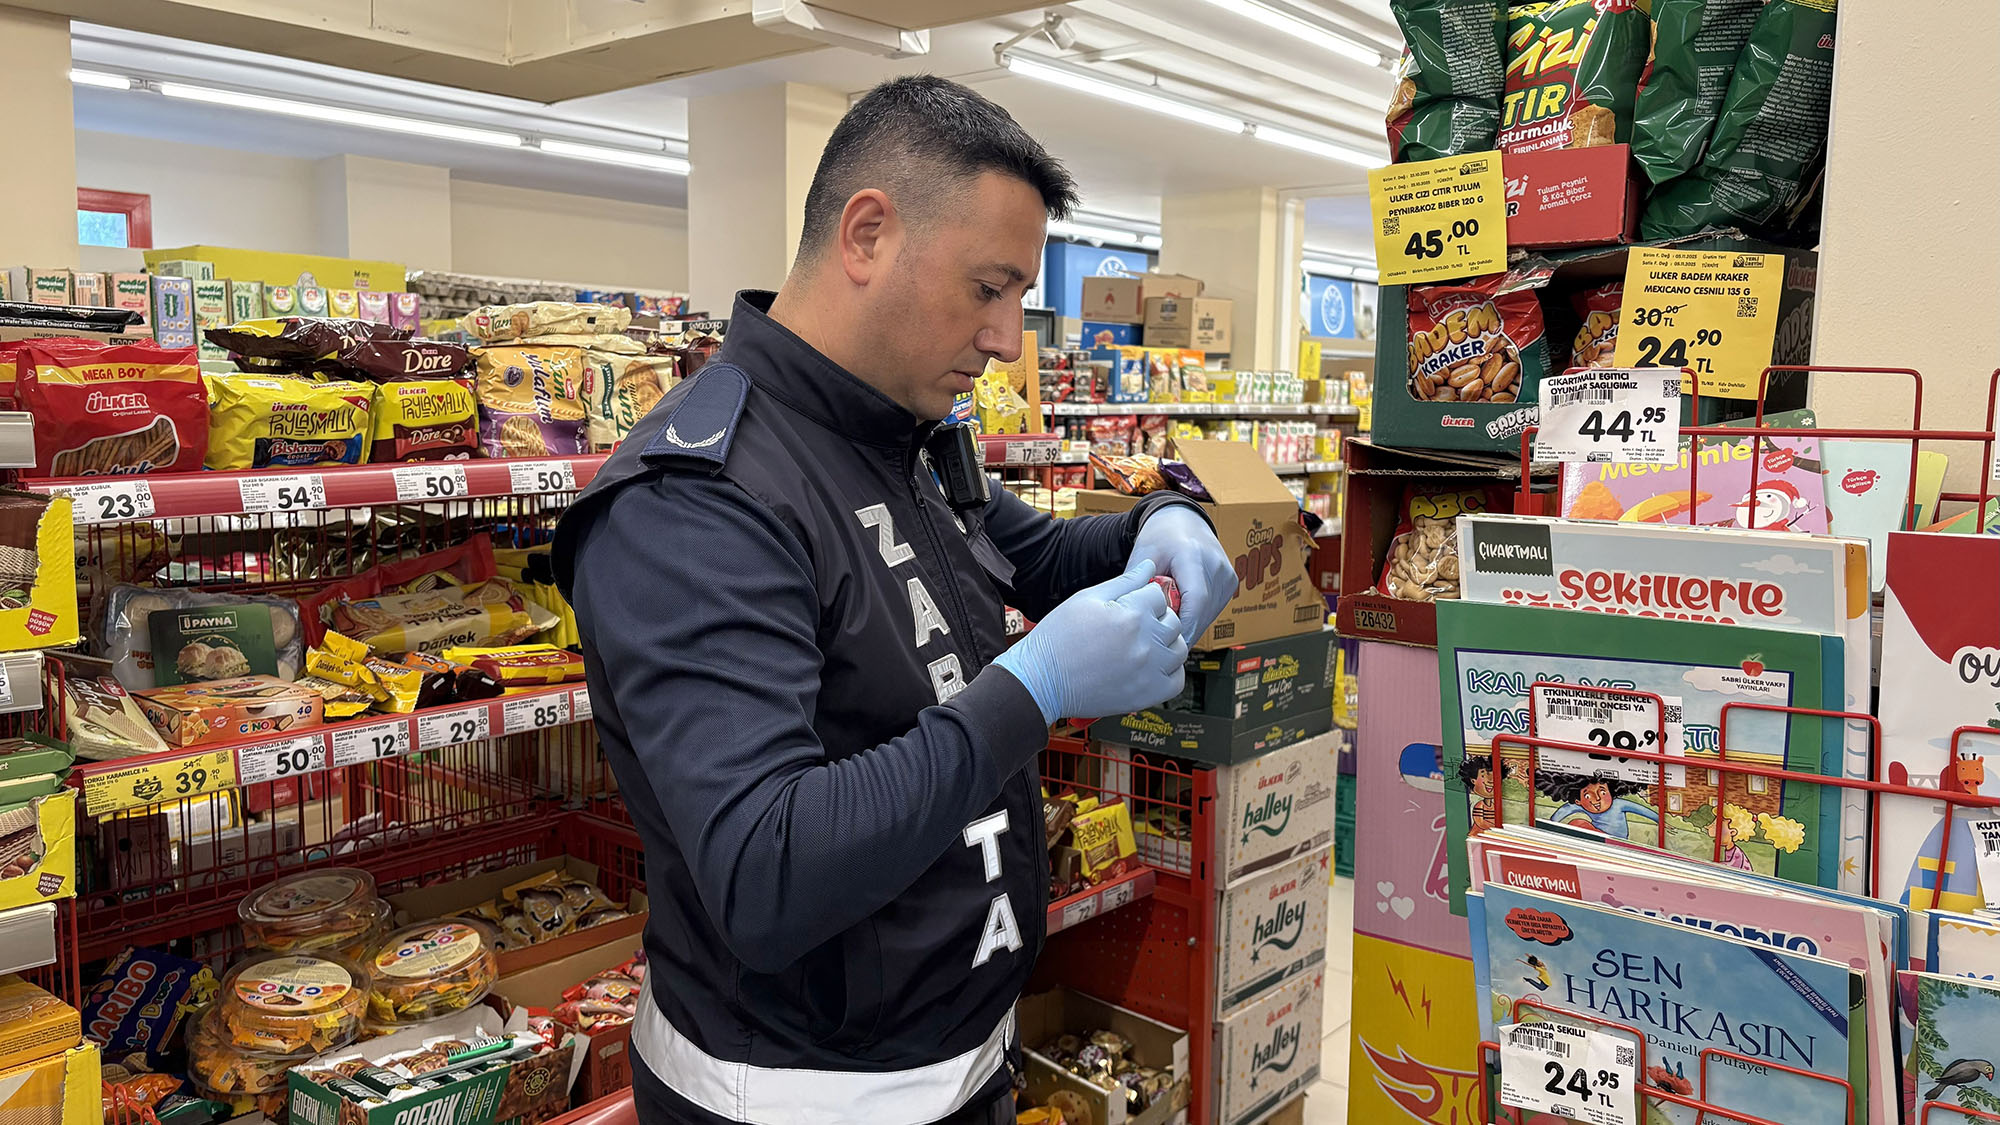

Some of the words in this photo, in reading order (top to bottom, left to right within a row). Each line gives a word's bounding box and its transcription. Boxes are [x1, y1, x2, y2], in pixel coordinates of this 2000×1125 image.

[1389, 192, 1414, 203] ULKER
[1415, 190, 1430, 199] CIZI
[1432, 186, 1452, 196] CITIR
[1452, 181, 1481, 193] TULUM
[1536, 184, 1560, 196] Tulum
[1561, 176, 1588, 190] Peyniri
[1542, 194, 1549, 202] &
[1550, 190, 1564, 201] Köz
[1566, 186, 1586, 197] Biber
[1388, 202, 1436, 217] PEYNIR&KOZ
[1438, 199, 1460, 210] BIBER
[1462, 196, 1474, 206] 120
[1478, 195, 1484, 203] G
[1538, 199, 1569, 212] Aromalı
[1570, 190, 1592, 205] Çerez
[1456, 244, 1471, 257] TL
[1649, 272, 1678, 280] ULKER
[1680, 272, 1712, 281] BADEM
[1714, 273, 1750, 282] KRAKER
[1644, 285, 1691, 294] MEXICANO
[1694, 287, 1726, 296] CESNILI
[1727, 288, 1741, 296] 135
[1743, 288, 1750, 296] G
[1664, 318, 1675, 327] TL
[404, 349, 452, 373] Dore
[1421, 340, 1486, 378] KRAKER
[1696, 358, 1714, 374] TL
[82, 368, 114, 382] MEGA
[118, 368, 146, 380] BOY
[1548, 372, 1597, 387] CIKARTMALI
[398, 387, 427, 395] ÜLKER
[1550, 382, 1588, 396] OYUNLAR
[1589, 381, 1638, 392] SAGLIGIMIZ
[86, 392, 150, 414] ÜLKER
[271, 402, 308, 412] ÜLKER
[401, 392, 469, 420] PAYLAŞMALIK
[1441, 414, 1475, 428] ÜLKER
[410, 430, 440, 445] Dore
[1640, 430, 1657, 443] TL
[271, 442, 323, 456] Biskrem
[1022, 448, 1032, 462] 17
[1044, 448, 1058, 462] 39
[426, 475, 466, 497] 50,00
[538, 470, 574, 491] 50,00
[98, 492, 151, 519] 23,00
[278, 486, 324, 510] 54,90
[1409, 489, 1486, 521] ABC
[1246, 527, 1274, 548] Gong
[1478, 541, 1548, 560] ÇIKARTMALI
[30, 618, 51, 628] DÜŞÜK
[43, 614, 54, 622] GÜN
[1360, 611, 1396, 630] 26432
[30, 624, 46, 633] FİYAT
[1721, 676, 1742, 684] SABRİ
[1742, 678, 1765, 686] ÜLKER
[1736, 684, 1770, 692] YAYINLARI
[1543, 689, 1605, 700] ETKINLIKLERLE
[296, 706, 312, 715] 40
[1546, 697, 1571, 706] TARIH
[1574, 698, 1598, 708] TARIH
[1600, 701, 1632, 711] ONCESI
[534, 704, 570, 727] 85,00
[334, 729, 354, 738] DANKEK
[354, 726, 368, 735] RULO
[450, 718, 488, 744] 29,50
[855, 502, 1024, 969] ZABTA
[372, 731, 410, 758] 12,00
[276, 746, 325, 775] 50,00
[84, 775, 105, 784] TORKU
[106, 769, 141, 780] KARAMELCE
[1258, 773, 1284, 790] ÜLKER
[1242, 792, 1293, 833] halley
[40, 880, 60, 888] DÜŞÜK
[1268, 879, 1296, 900] ÜLKER
[1507, 870, 1576, 893] ÇIKARTMALI
[1078, 906, 1090, 922] 72
[1252, 900, 1306, 945] halley
[1592, 948, 1682, 990] SEN
[84, 960, 157, 1050] ARIBO
[1563, 974, 1816, 1068] HARİKASIN
[1557, 1026, 1586, 1038] SEKILLI
[1251, 1021, 1301, 1072] halley
[292, 1088, 321, 1125] GOFRİK
[1597, 1092, 1614, 1108] TL
